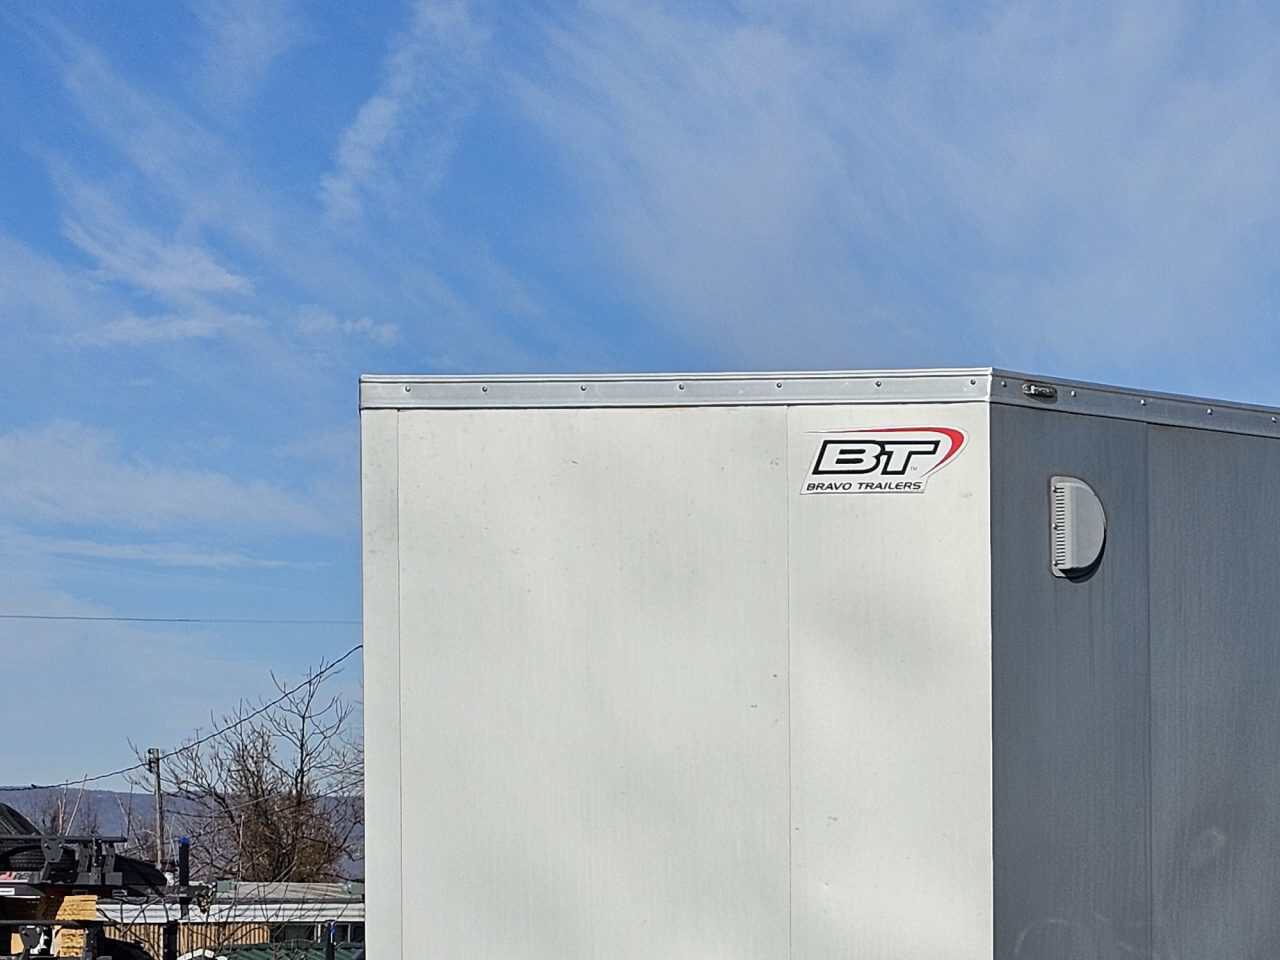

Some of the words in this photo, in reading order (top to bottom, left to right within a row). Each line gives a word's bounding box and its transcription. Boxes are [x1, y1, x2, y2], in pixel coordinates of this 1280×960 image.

[812, 440, 940, 475] BT
[806, 482, 852, 491] BRAVO
[858, 481, 922, 490] TRAILERS
